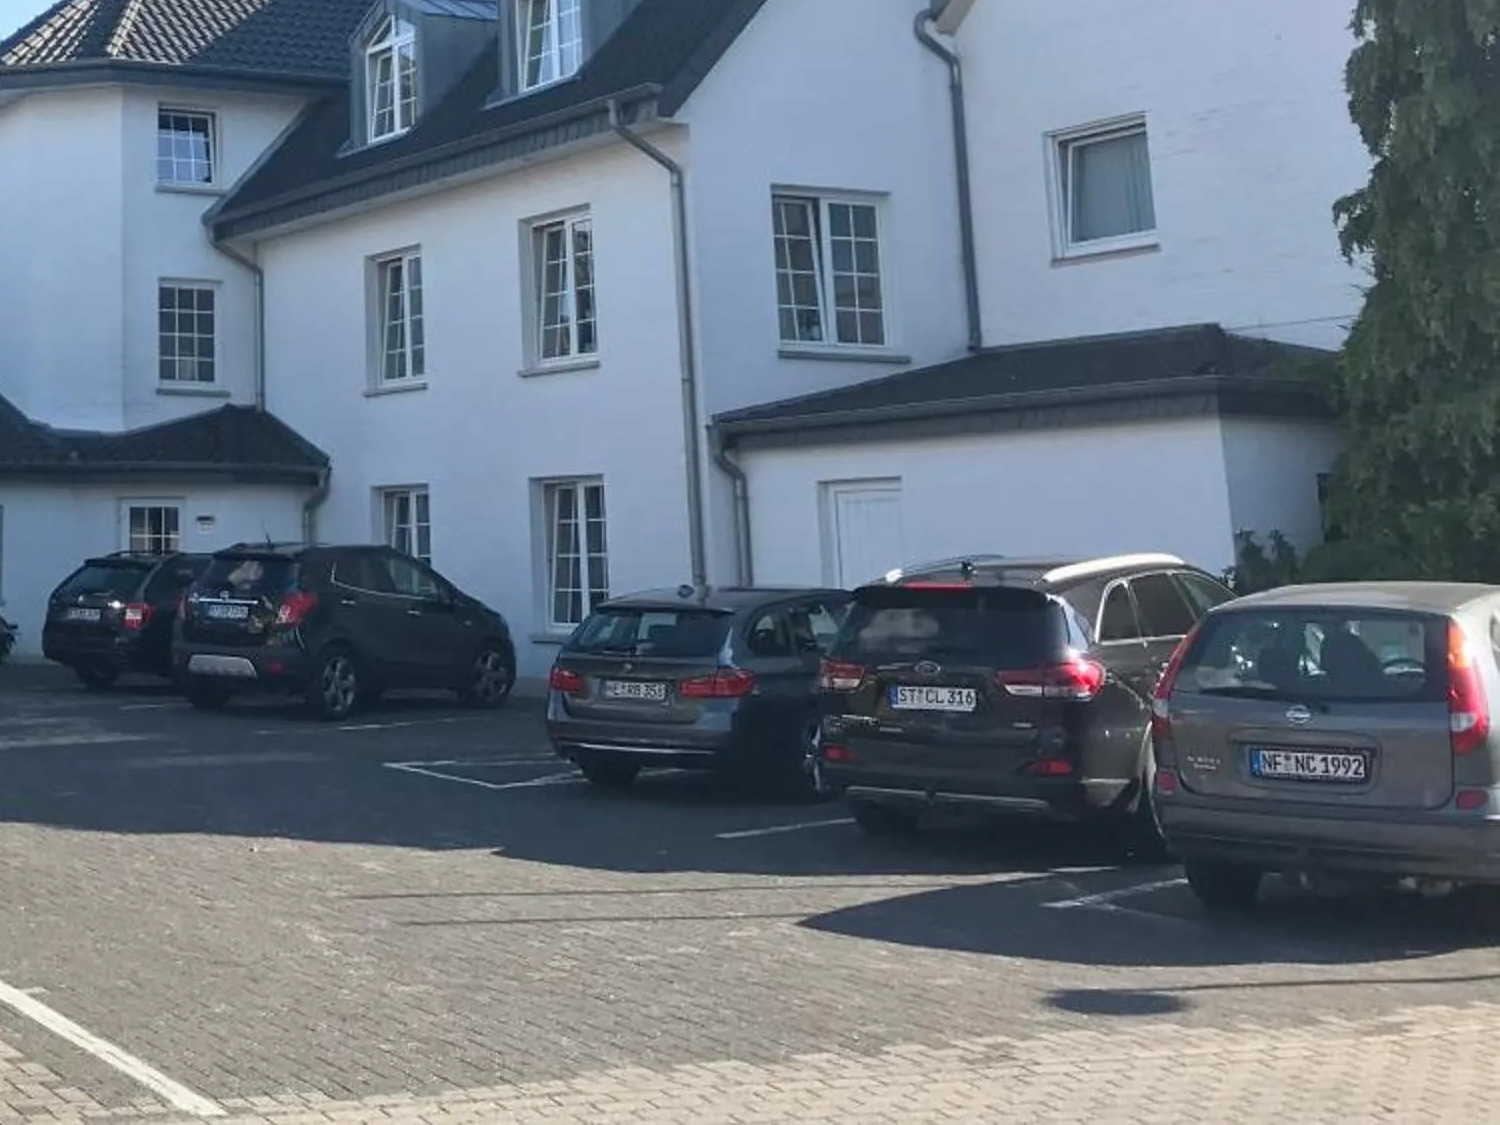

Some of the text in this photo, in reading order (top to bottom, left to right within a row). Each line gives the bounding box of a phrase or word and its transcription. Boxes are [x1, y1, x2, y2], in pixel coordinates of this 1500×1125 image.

[899, 688, 974, 706] ST CL 316
[1261, 753, 1363, 776] NF NC 1992
